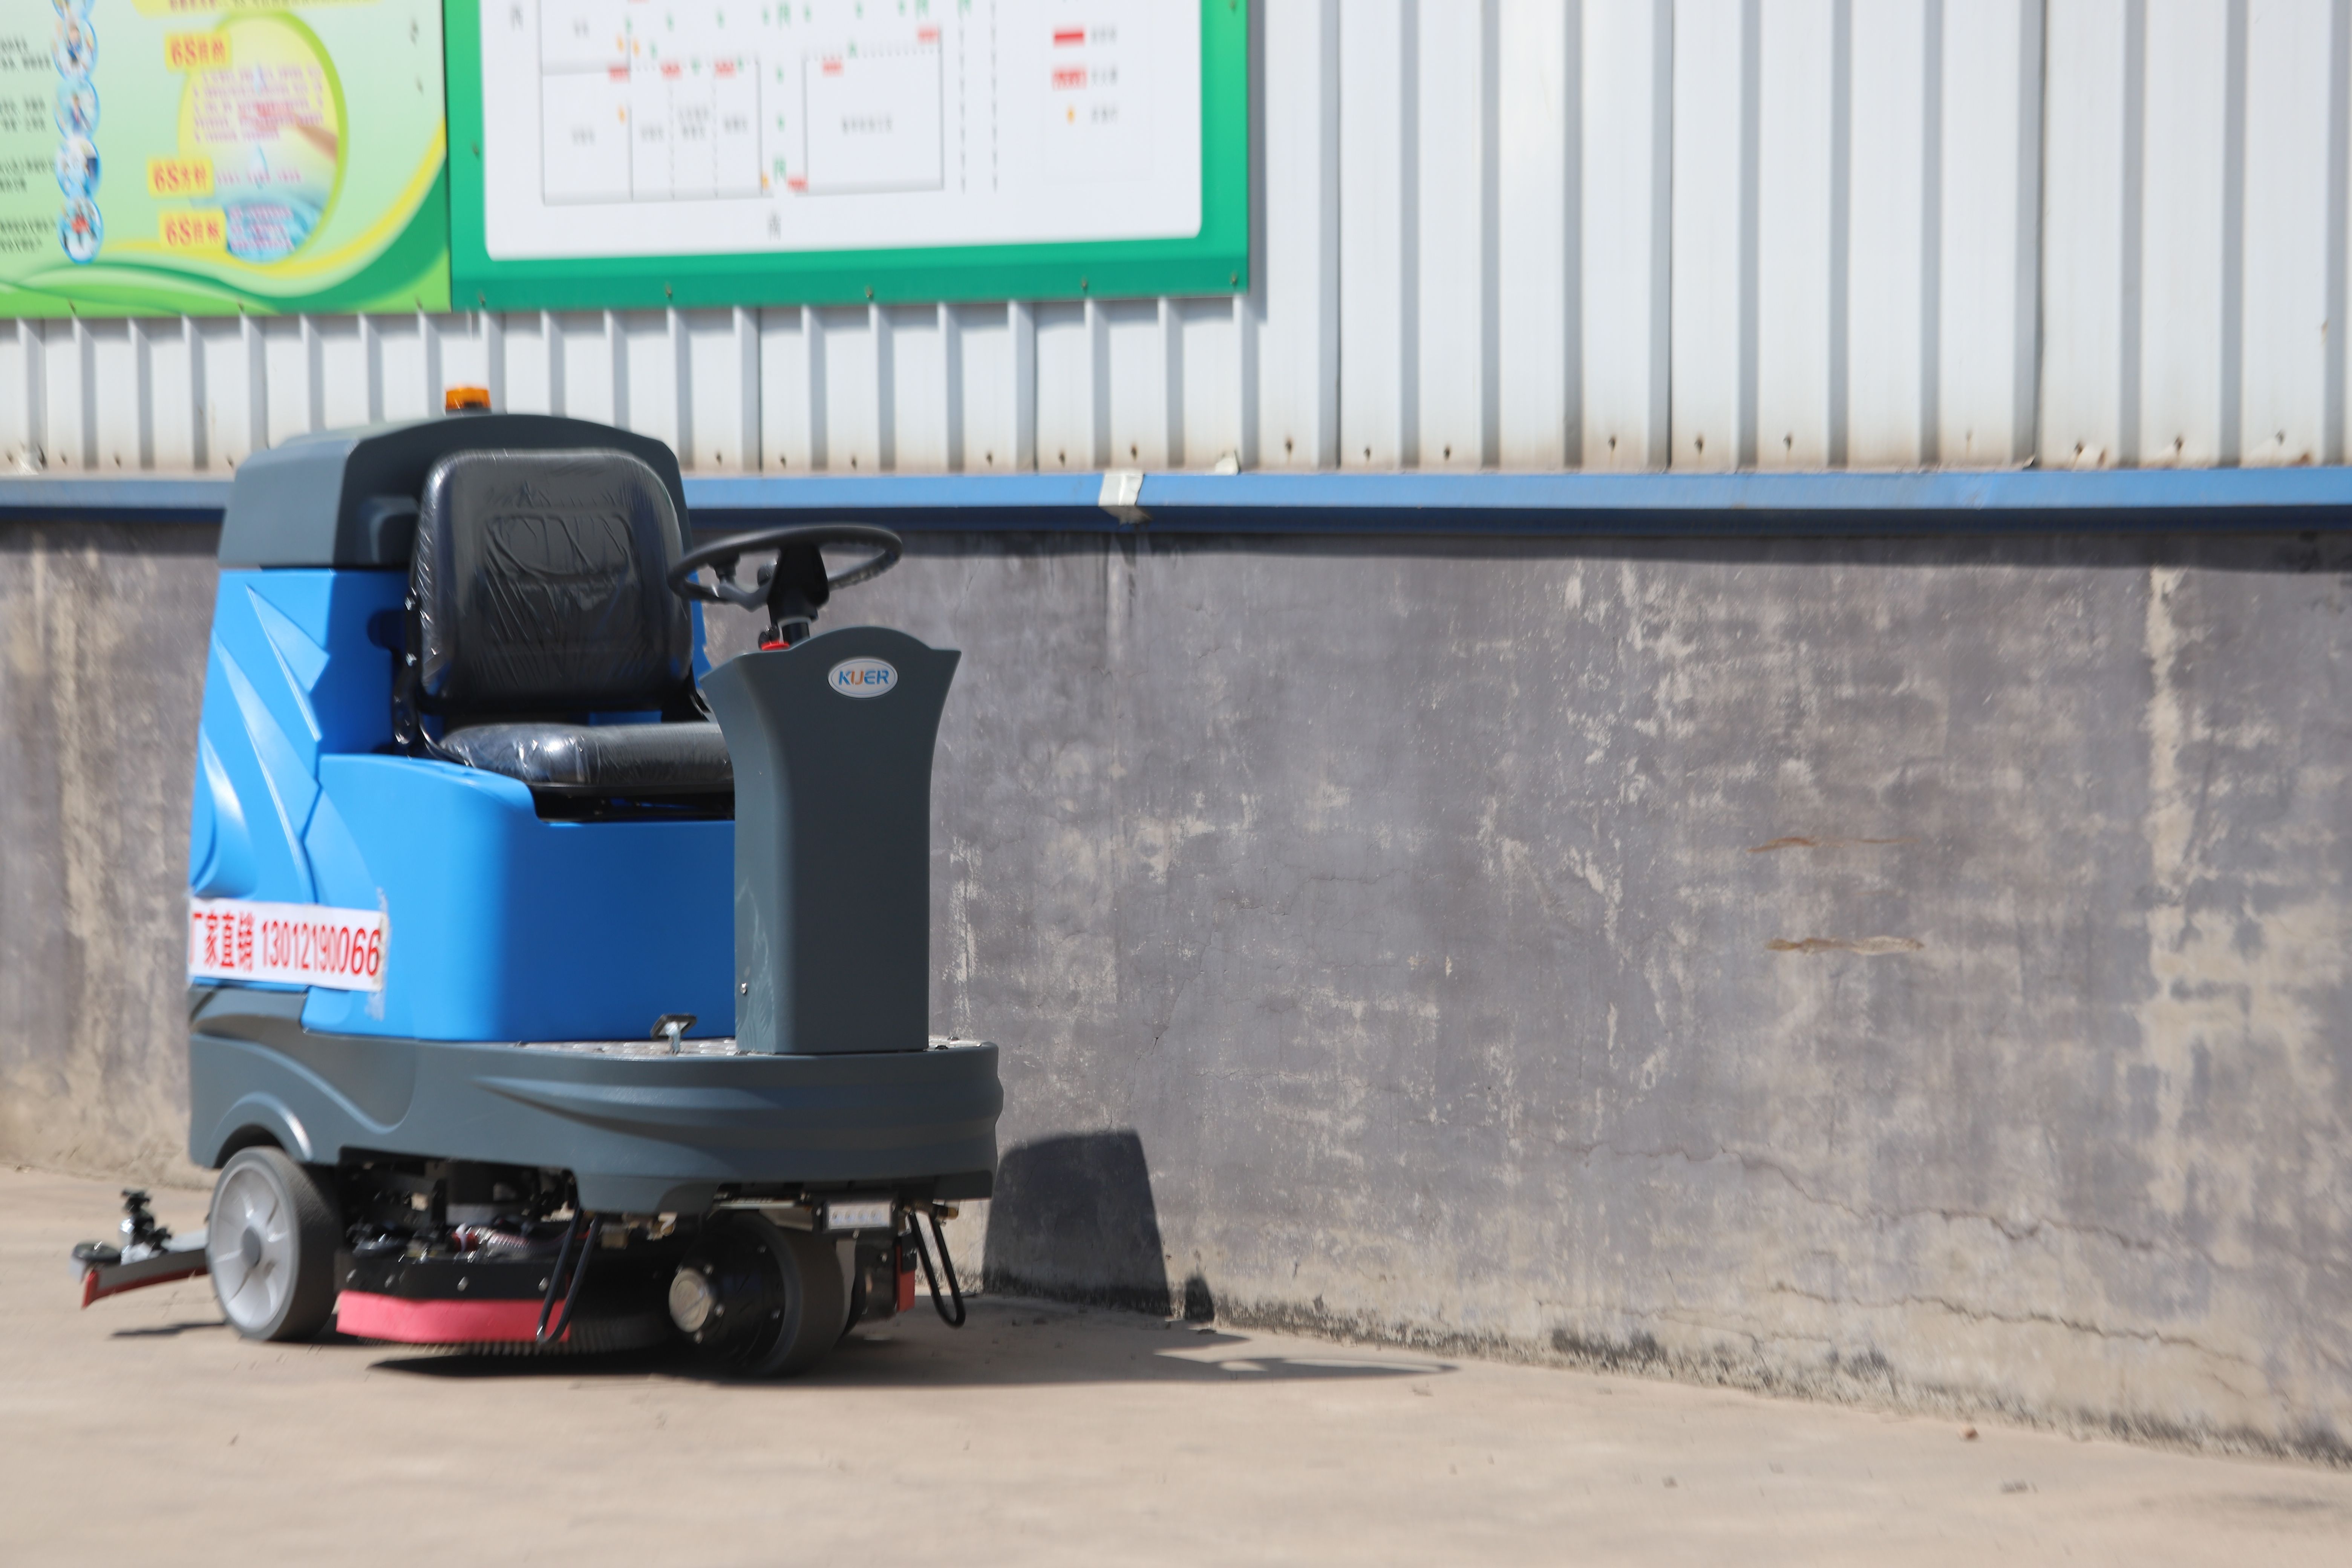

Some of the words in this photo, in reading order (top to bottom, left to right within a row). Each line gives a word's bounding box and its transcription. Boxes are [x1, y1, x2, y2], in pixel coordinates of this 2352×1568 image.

[839, 670, 889, 685] KUER
[189, 910, 255, 972] 厂家直销
[262, 920, 381, 977] 13012190066
